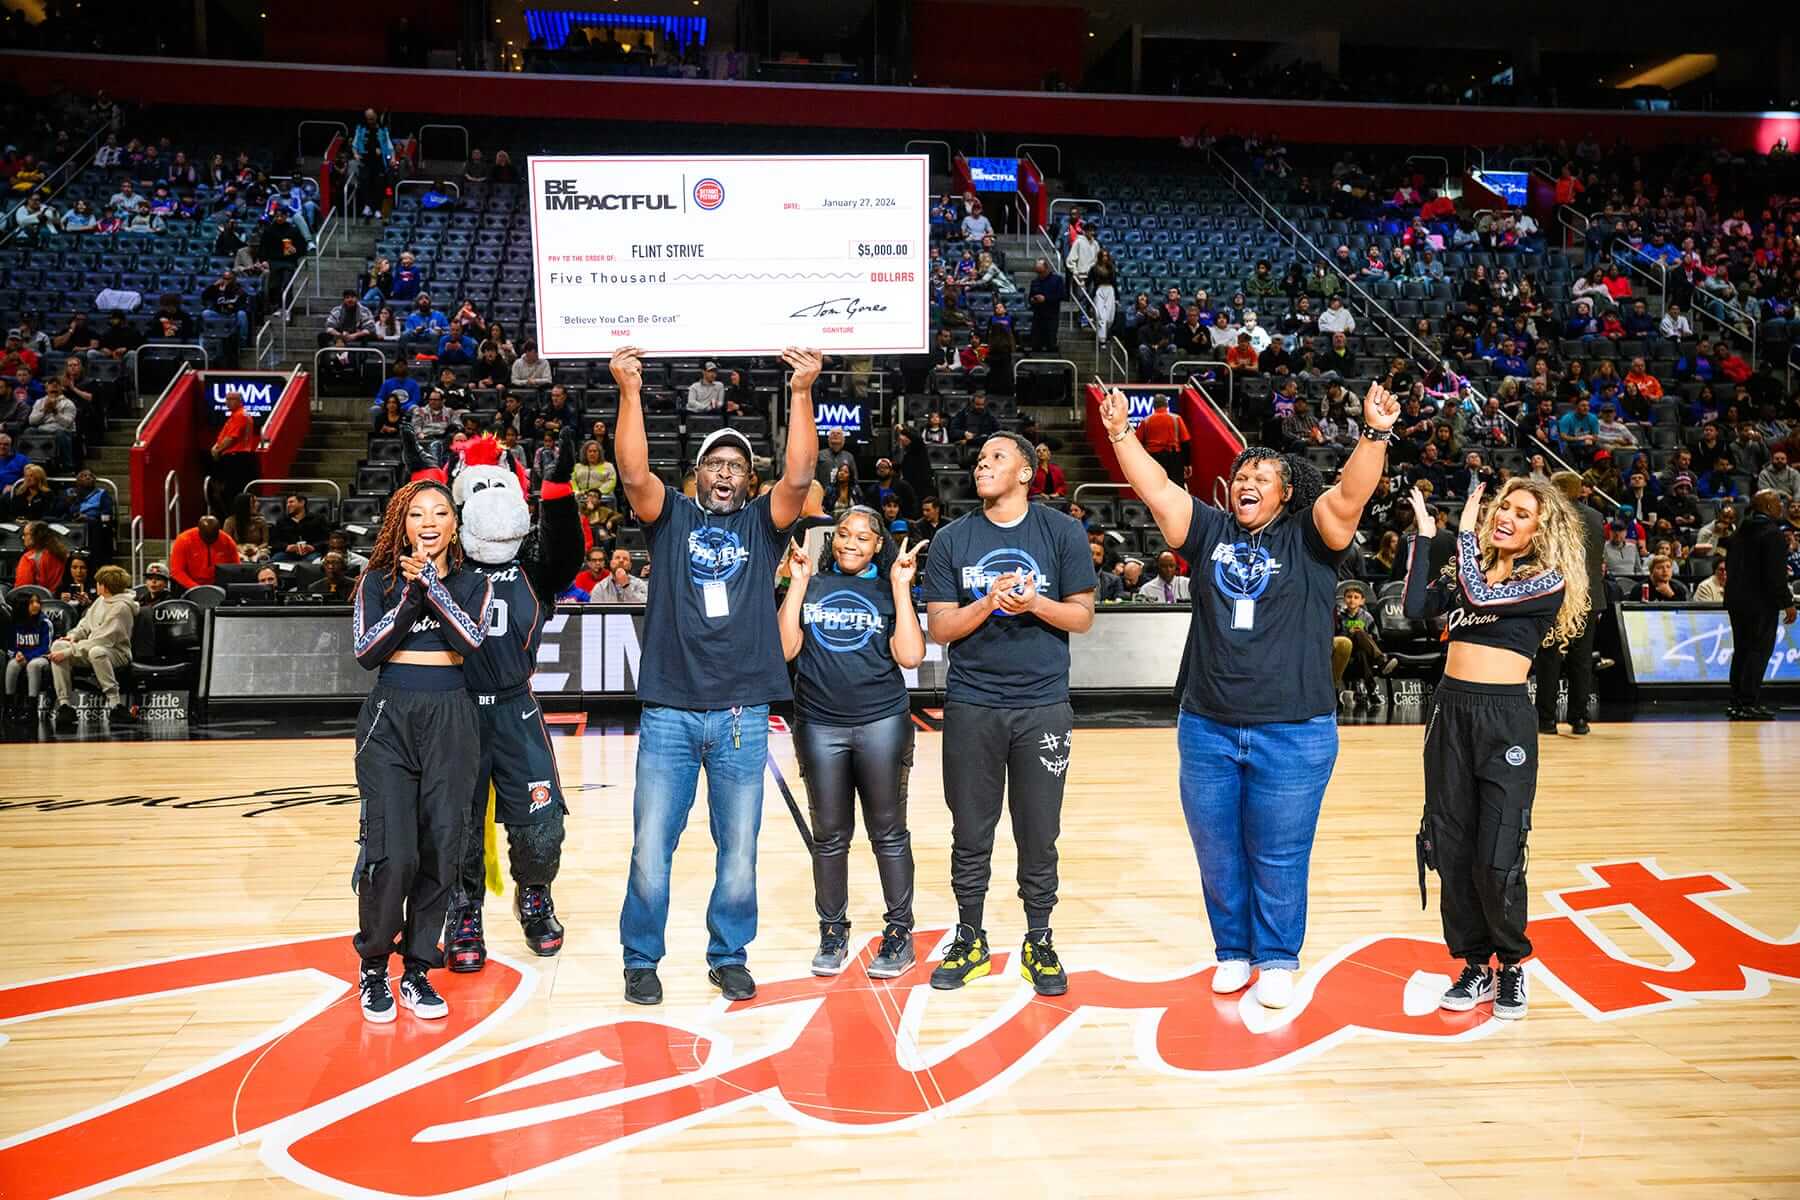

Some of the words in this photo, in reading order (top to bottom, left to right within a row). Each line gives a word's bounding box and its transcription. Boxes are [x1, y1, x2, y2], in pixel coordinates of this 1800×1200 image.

[544, 179, 578, 195] BE
[545, 194, 677, 211] IMPACTFUL
[783, 202, 801, 210] DATE:
[821, 198, 857, 208] January
[859, 199, 873, 208] 27,
[875, 198, 896, 207] 2024
[631, 244, 663, 259] FLINT
[666, 243, 705, 258] STRIVE
[857, 242, 909, 258] $5,000.00
[550, 272, 583, 284] Five
[590, 271, 667, 284] Thousand
[870, 271, 915, 283] DOLLARS
[789, 297, 852, 318] Tom
[599, 314, 616, 324] You
[617, 314, 635, 324] Can
[637, 314, 650, 323] Be
[822, 326, 855, 334] SIGNATURE
[214, 383, 272, 404] UWM
[962, 566, 984, 577] BE
[154, 608, 190, 621] UWM
[803, 602, 824, 613] BE
[803, 609, 885, 630] IMPACTFUL
[1448, 607, 1500, 631] Detroit
[141, 693, 180, 709] Little
[478, 695, 496, 705] DET
[139, 707, 185, 721] aesars
